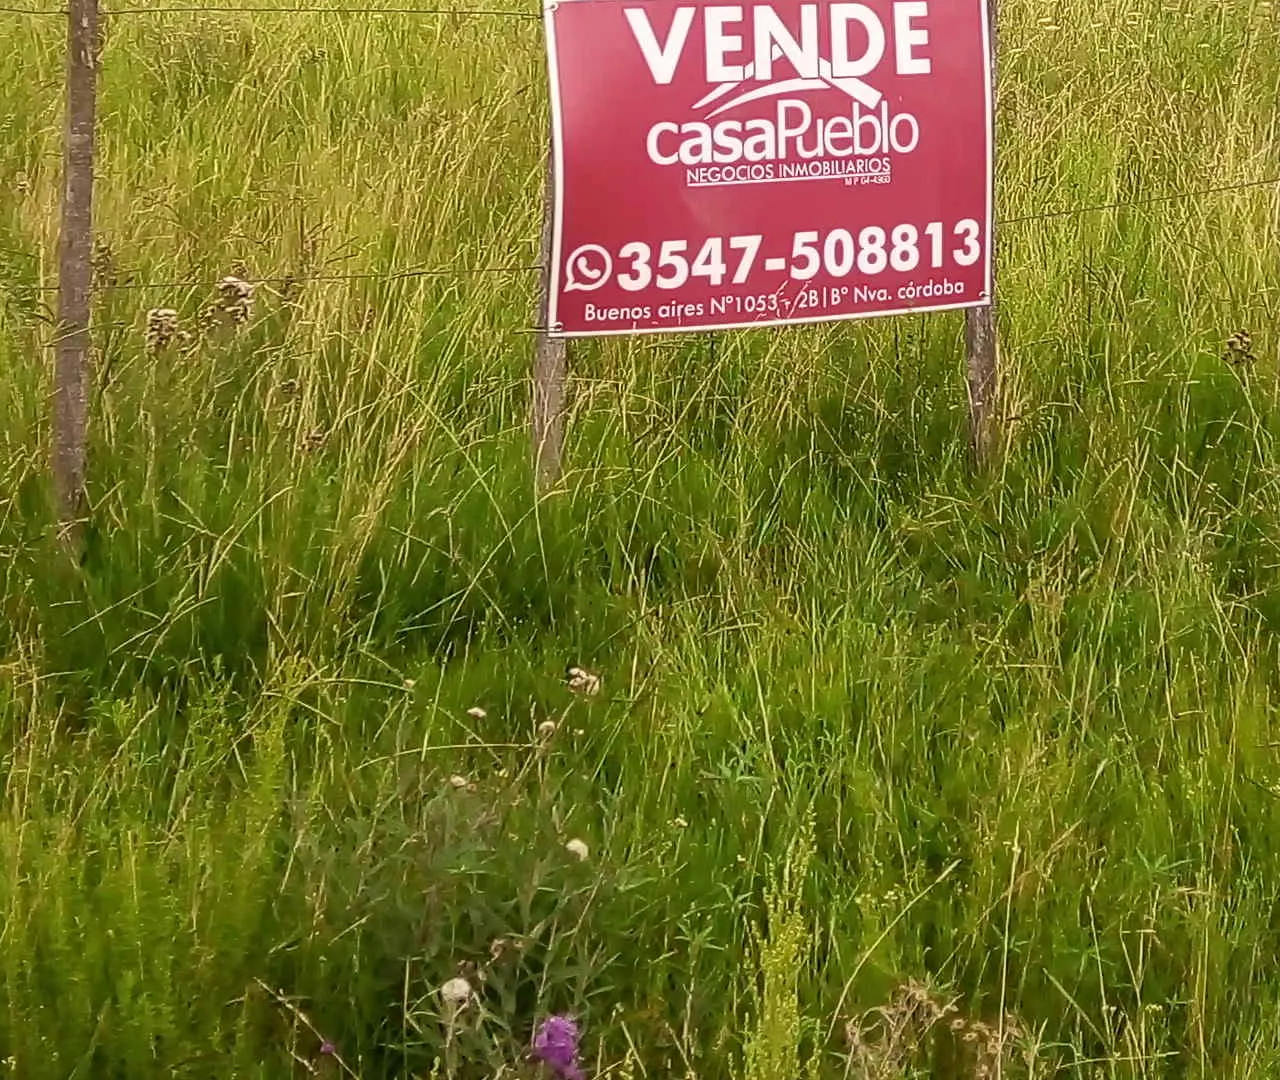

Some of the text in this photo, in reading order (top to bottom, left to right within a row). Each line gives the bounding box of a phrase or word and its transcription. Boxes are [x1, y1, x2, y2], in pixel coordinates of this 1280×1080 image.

[623, 1, 932, 85] VENDE
[646, 99, 920, 166] casaPueblo
[686, 157, 891, 183] NEGOCIOS INMOBILIARIOS
[617, 217, 981, 290] 3547-508813
[584, 303, 651, 321] Buenos
[657, 300, 704, 319] aires
[853, 285, 893, 304] Nva.
[897, 277, 965, 299] córdoba
